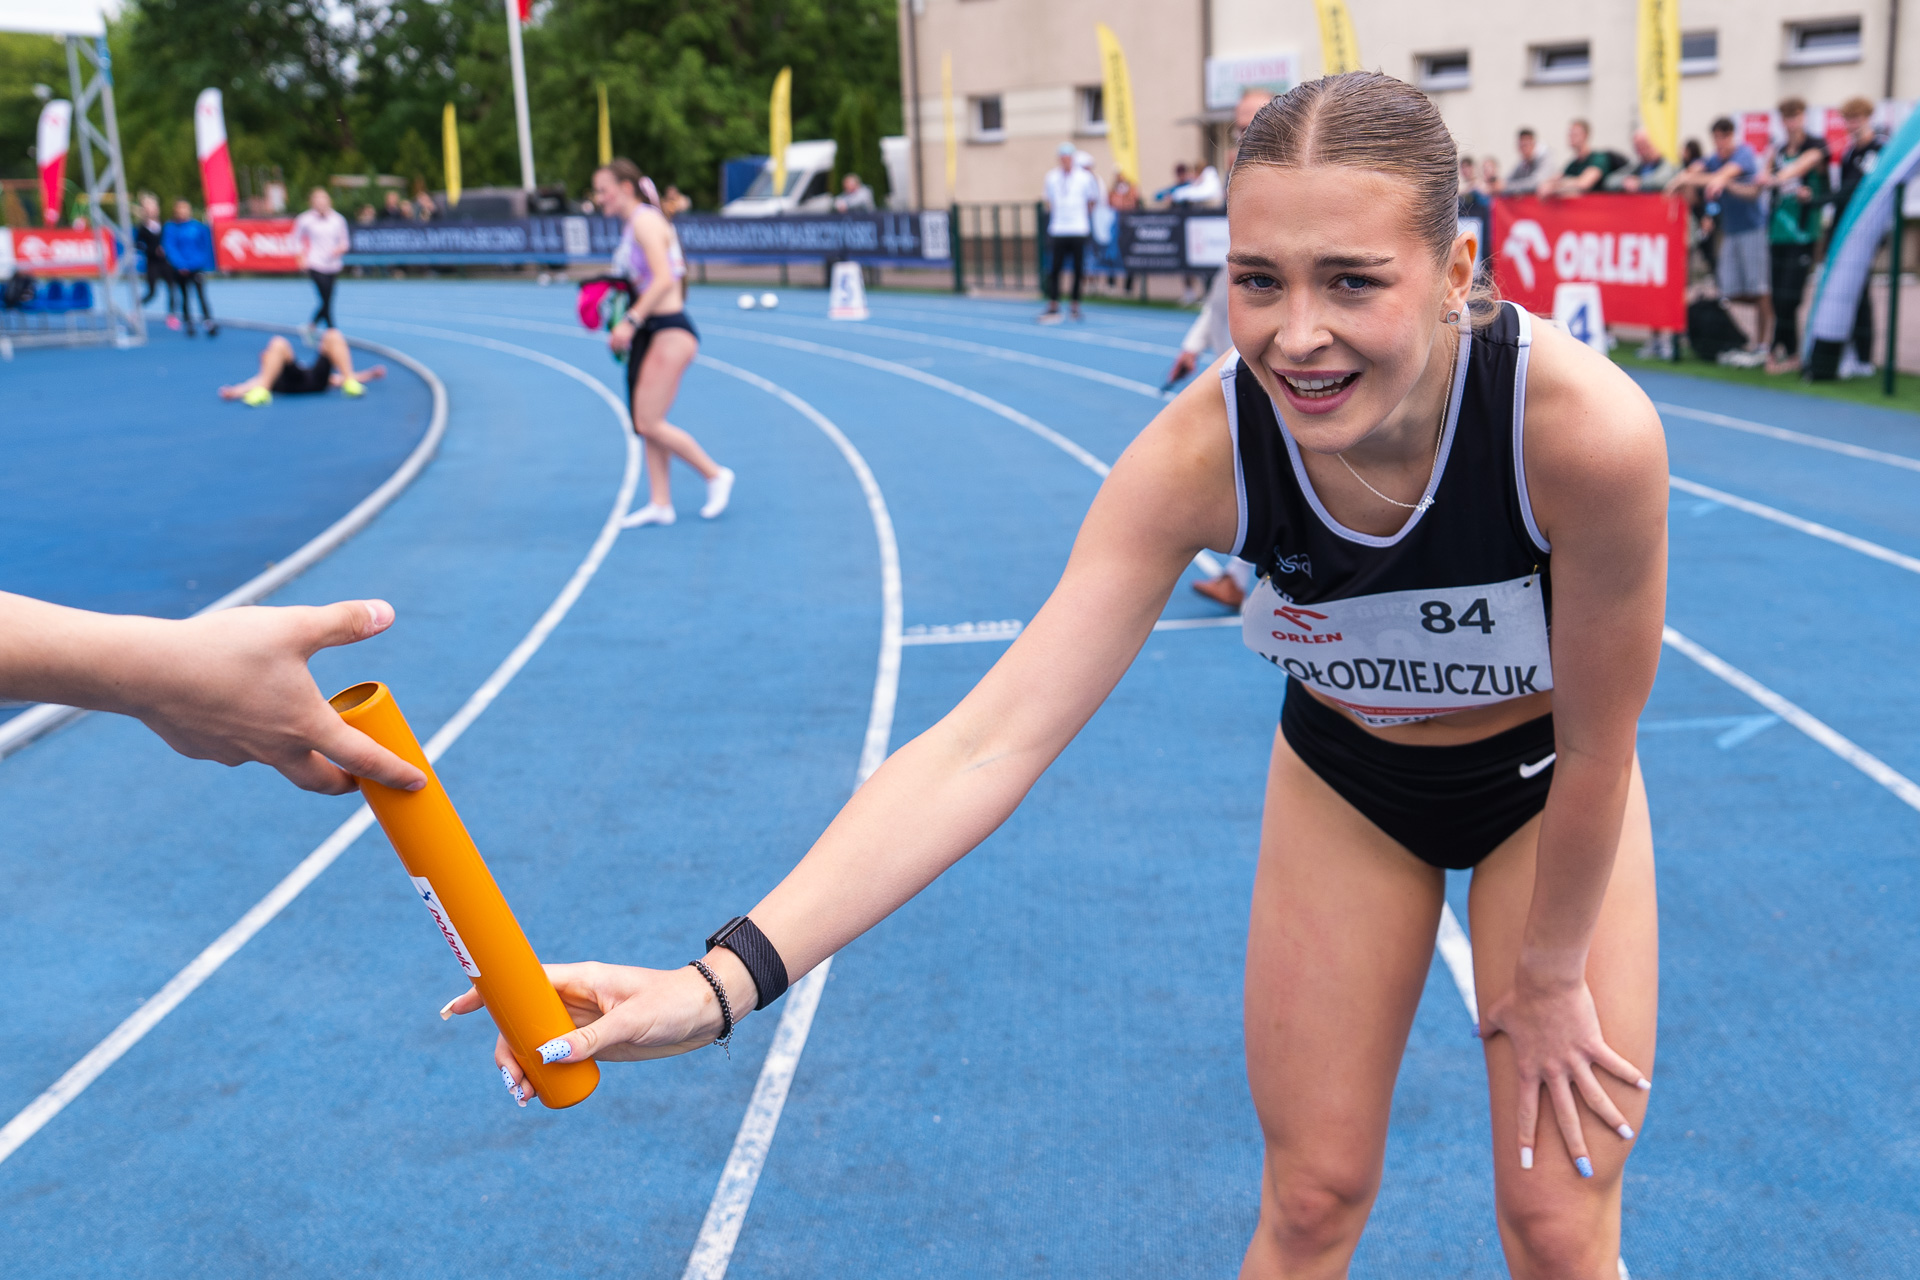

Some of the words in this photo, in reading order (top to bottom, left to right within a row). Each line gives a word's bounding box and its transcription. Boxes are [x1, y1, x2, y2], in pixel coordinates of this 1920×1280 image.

[1554, 230, 1668, 287] ORLEN
[1567, 303, 1591, 343] 4
[1419, 597, 1496, 635] 84
[1271, 630, 1343, 644] ORLEN
[426, 905, 472, 972] polanik
